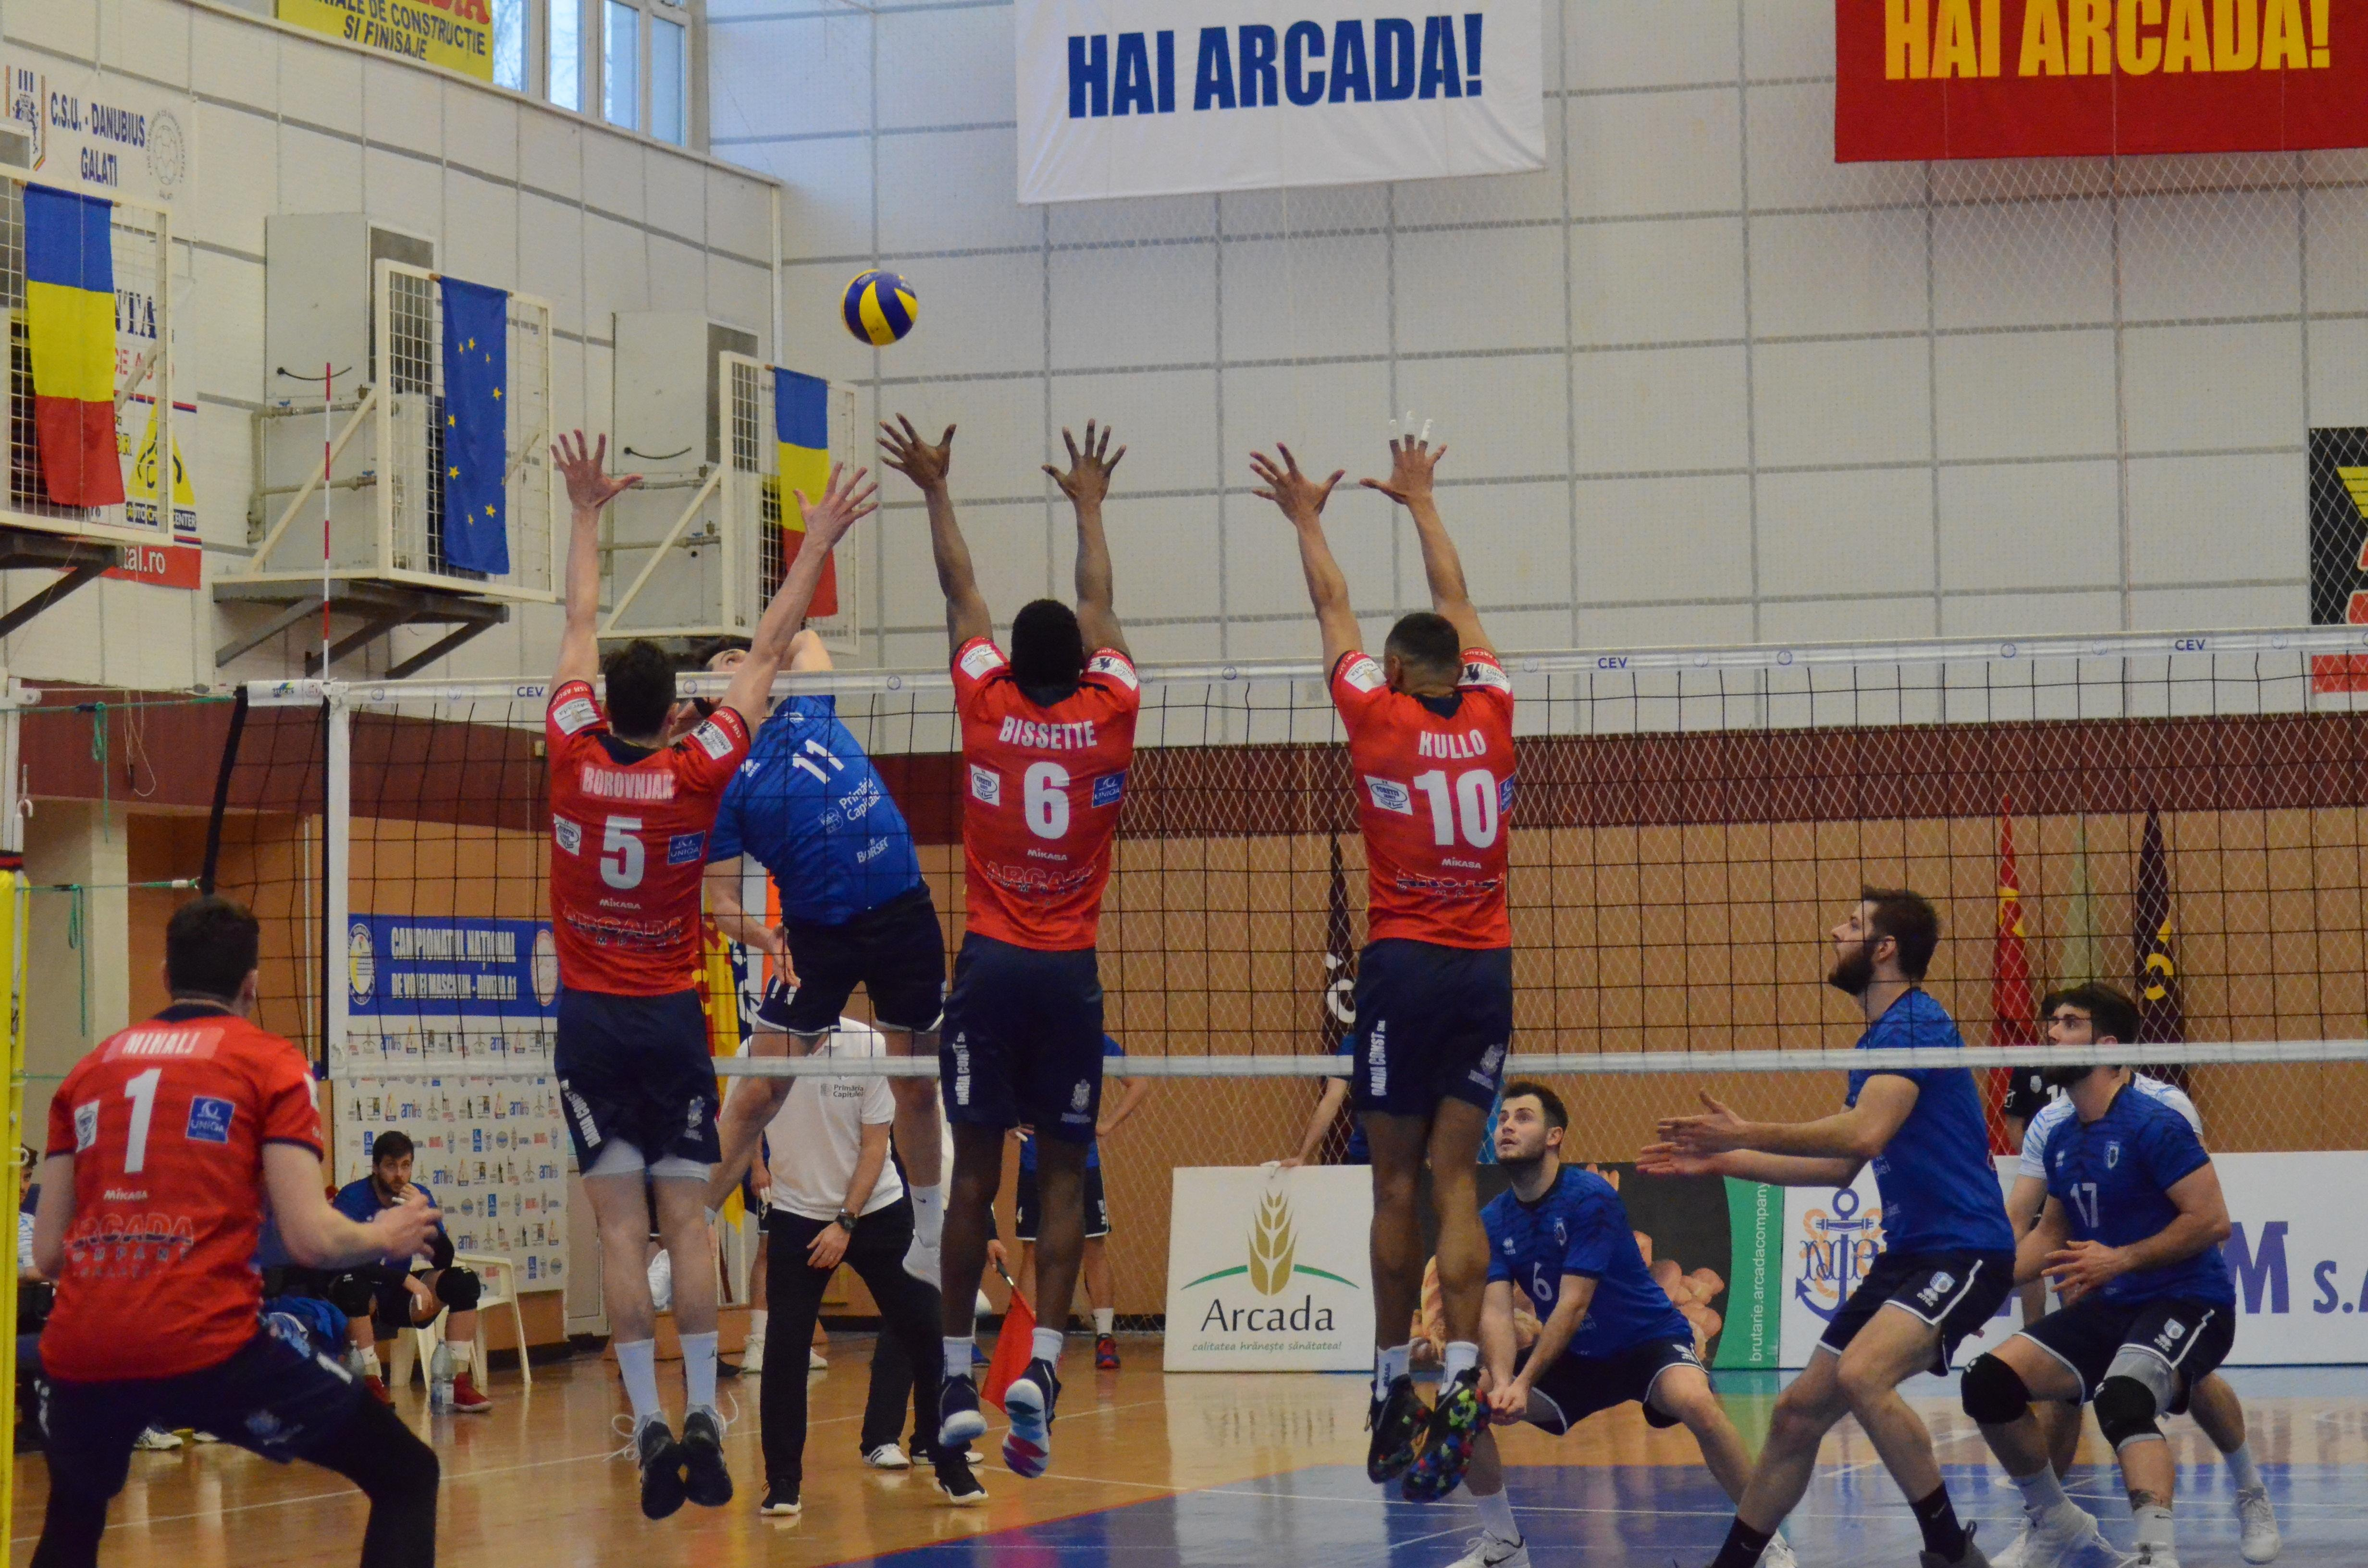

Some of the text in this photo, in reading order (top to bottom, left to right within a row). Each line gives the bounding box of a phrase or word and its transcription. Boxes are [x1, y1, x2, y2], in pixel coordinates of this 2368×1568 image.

[344, 15, 427, 61] SI FINISAJE
[1885, 0, 2330, 80] HAI ARCADA!
[1068, 13, 1483, 119] HAI ARCADA!
[51, 91, 82, 131] C.S.U.
[91, 102, 145, 148] DANUBIUS
[81, 146, 118, 187] GALATI
[1598, 657, 1628, 669] CEV
[2174, 639, 2206, 651] CEV
[517, 686, 544, 698] CEV
[999, 716, 1098, 750] BISSETTE
[1418, 729, 1487, 759] KULLO
[792, 738, 845, 784] 11
[582, 767, 675, 800] BOROVNJAK
[1024, 761, 1070, 839] 6
[1413, 769, 1498, 848] 10
[600, 815, 645, 890] 5
[391, 927, 466, 961] CAMPIONATUL
[391, 973, 403, 999] DE
[403, 973, 427, 999] VOLEI
[428, 973, 471, 999] MASCULIN
[477, 974, 506, 1000] DIVIZIA
[506, 976, 517, 1001] A1
[1368, 1032, 1386, 1066] CONST
[123, 1068, 162, 1174] 1
[2070, 1183, 2099, 1228] 17
[1533, 1262, 1553, 1301] 6
[2313, 1260, 2368, 1314] S.
[1200, 1295, 1335, 1332] Arcada
[1192, 1341, 1235, 1352] calitatea
